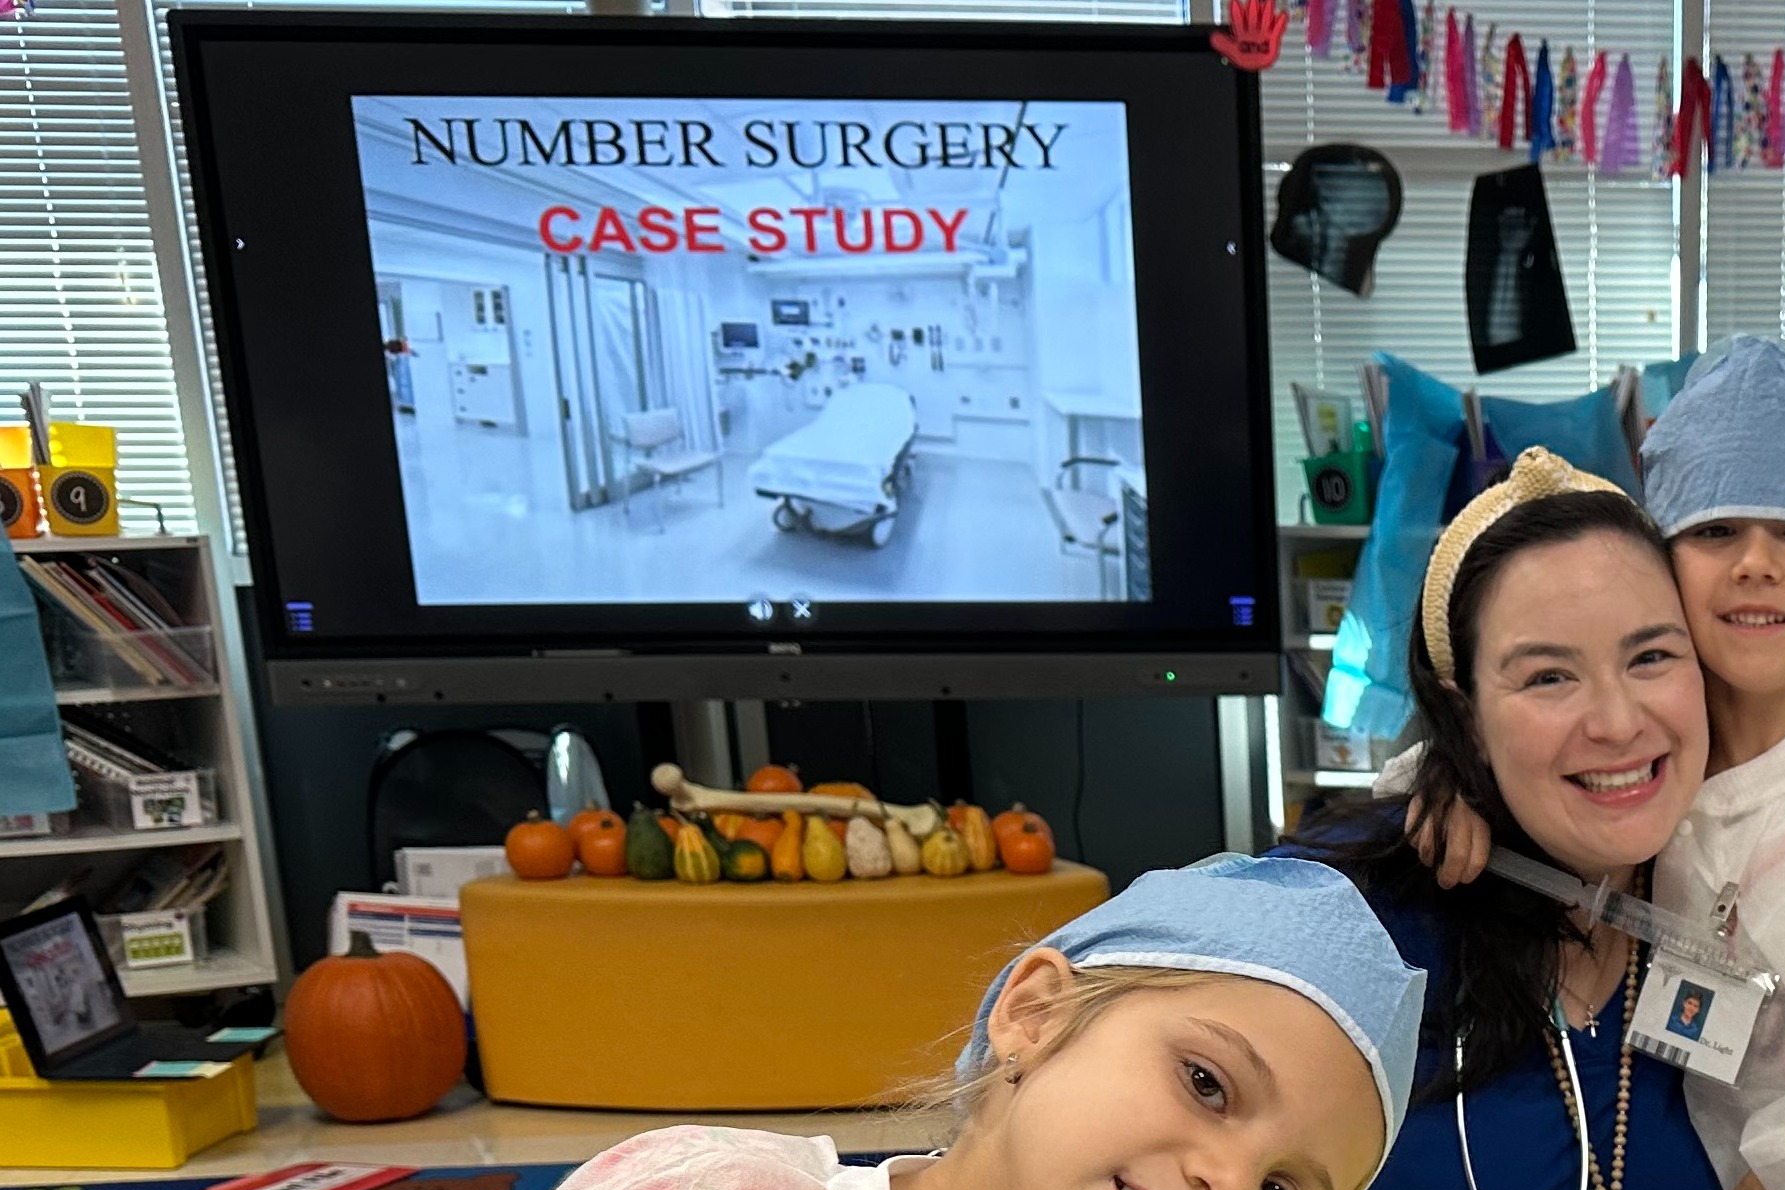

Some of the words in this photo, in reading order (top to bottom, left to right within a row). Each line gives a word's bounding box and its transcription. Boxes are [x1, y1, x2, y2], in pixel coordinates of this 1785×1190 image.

[405, 117, 725, 169] NUMBER
[745, 119, 1068, 171] SURGERY
[538, 207, 725, 254] CASE
[749, 208, 969, 254] STUDY
[70, 486, 87, 512] 9
